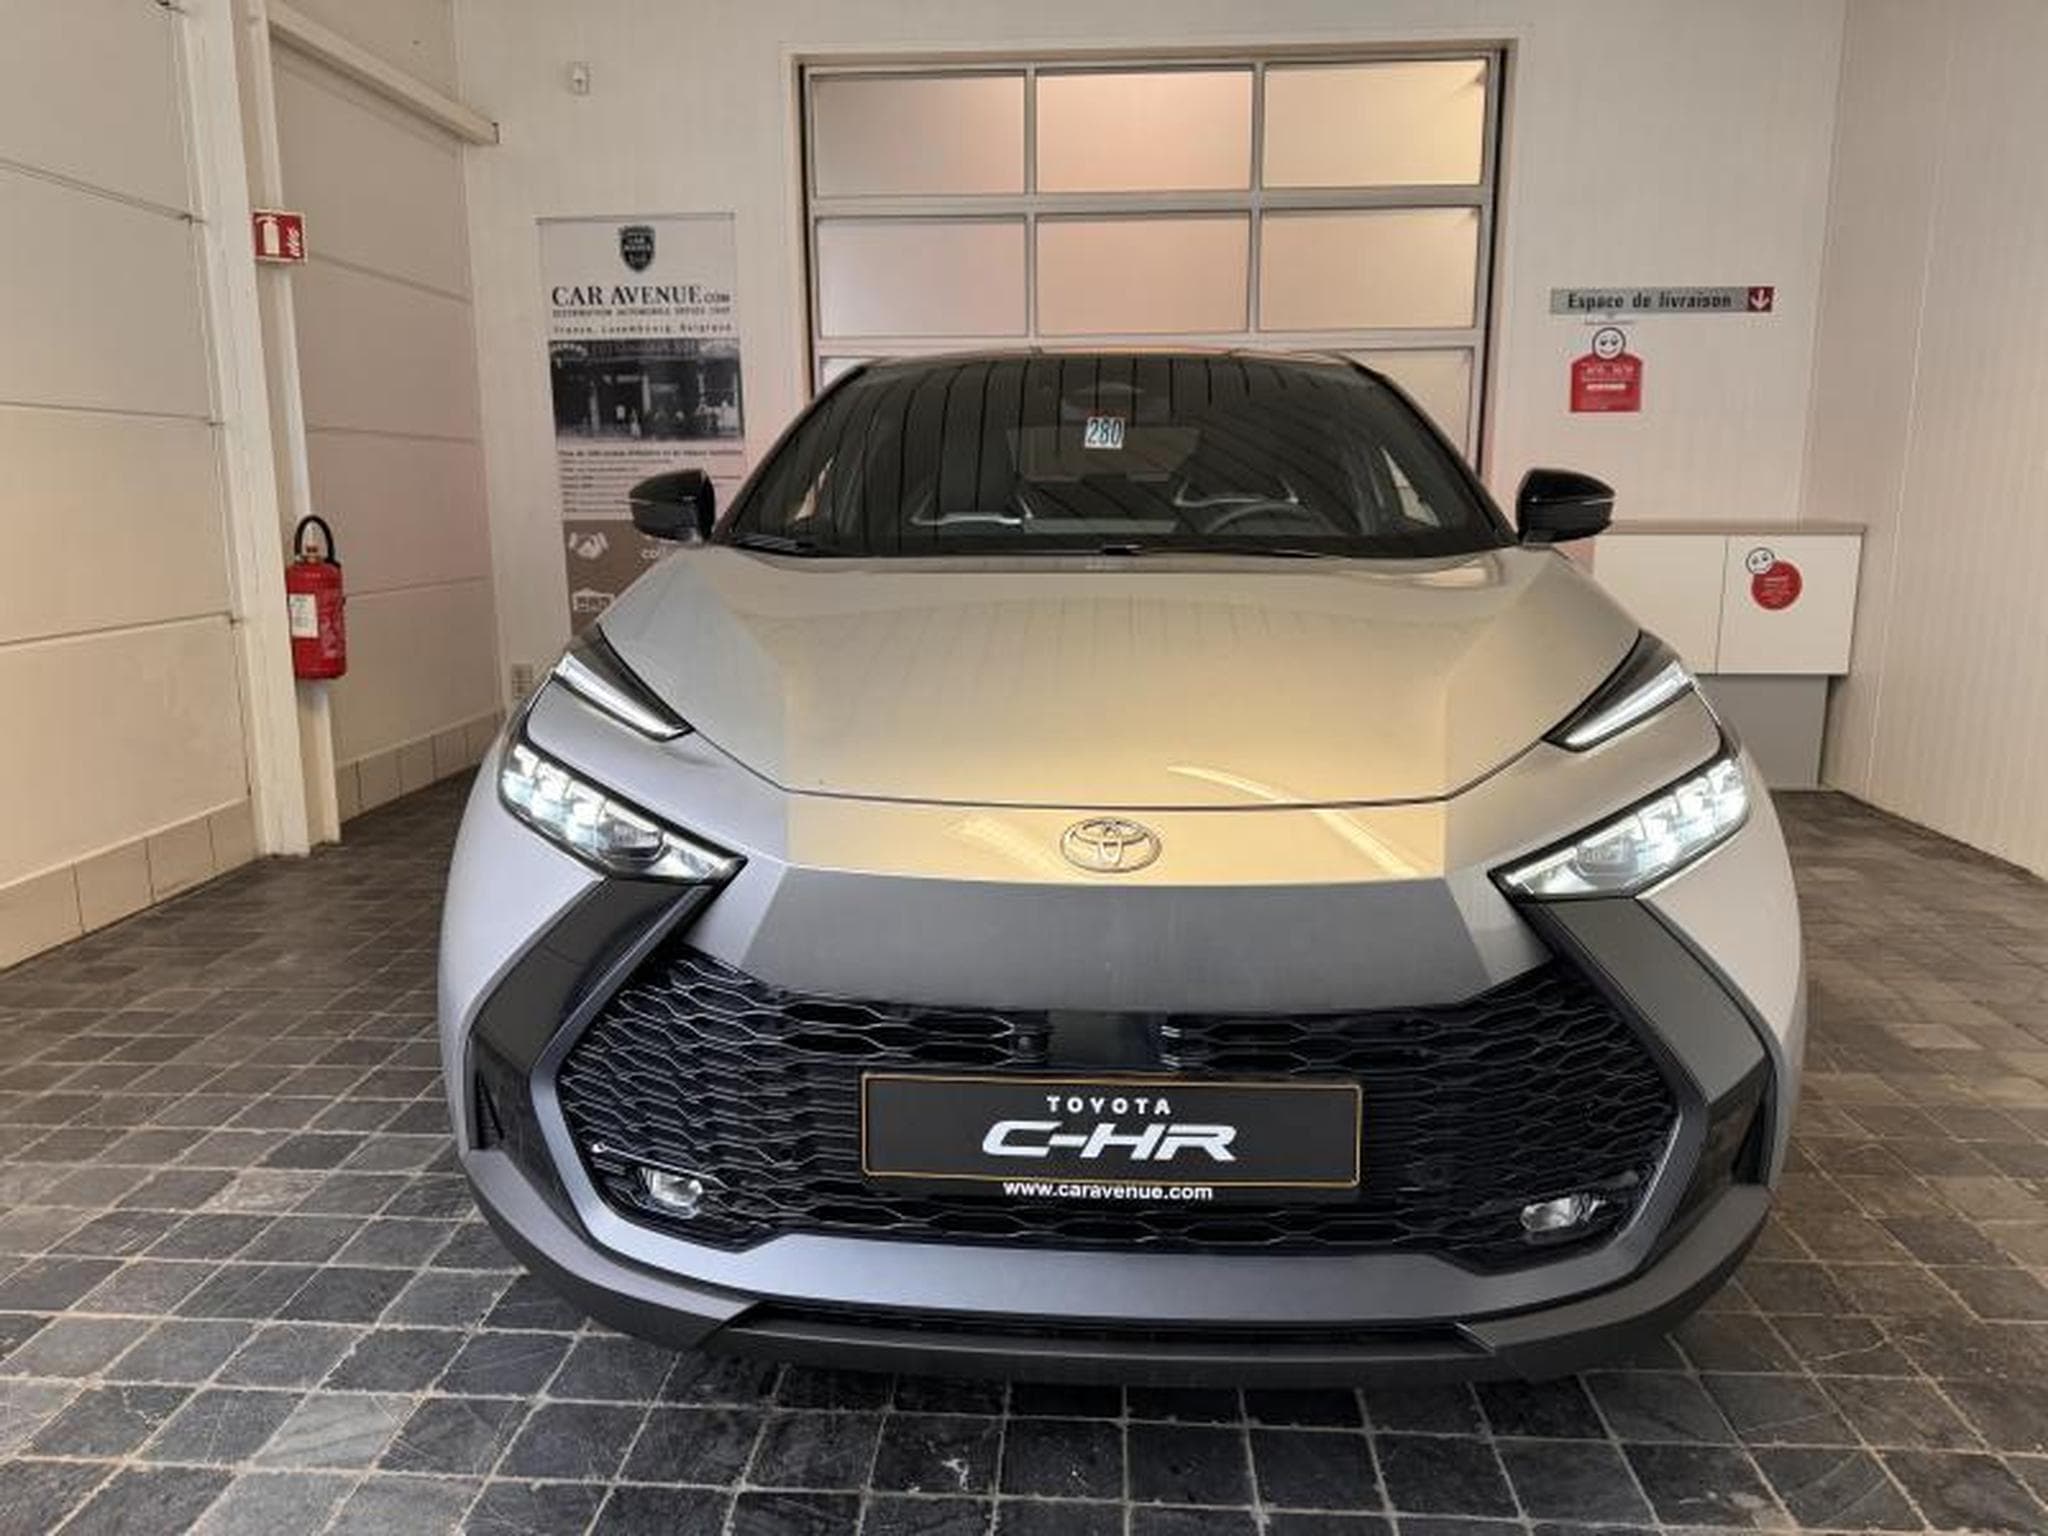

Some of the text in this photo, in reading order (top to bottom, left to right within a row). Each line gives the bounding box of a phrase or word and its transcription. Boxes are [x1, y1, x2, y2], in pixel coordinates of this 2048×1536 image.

[552, 286, 603, 306] CAR
[1568, 291, 1732, 312] Espace de livraison
[1088, 418, 1122, 446] 280
[1046, 1095, 1172, 1116] TOYOTA
[981, 1119, 1238, 1162] C-HR
[1003, 1179, 1214, 1201] www.caravenue.com
